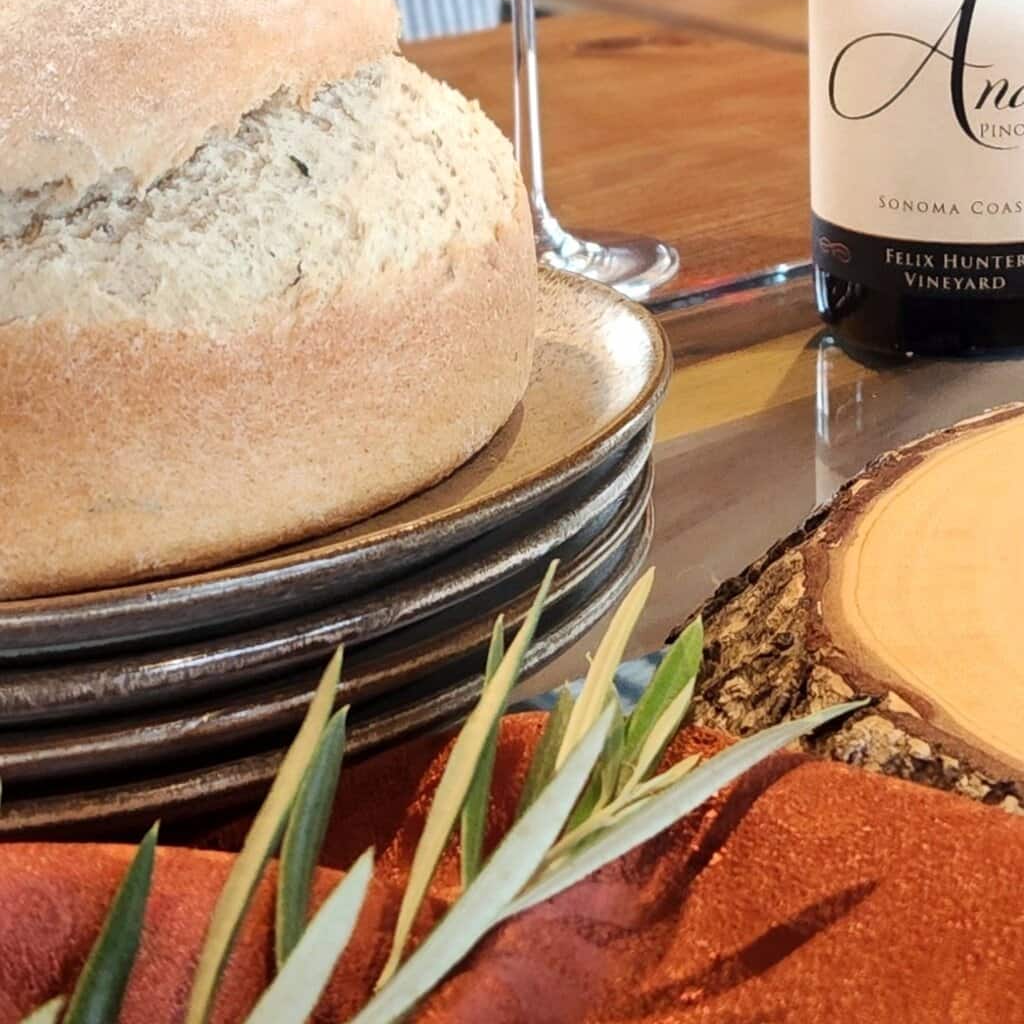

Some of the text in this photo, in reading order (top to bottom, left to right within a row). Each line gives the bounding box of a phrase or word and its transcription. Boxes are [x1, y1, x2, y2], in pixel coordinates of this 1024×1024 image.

[879, 195, 960, 215] SONOMA
[885, 248, 935, 268] FELIX
[904, 273, 1007, 291] VINEYARD
